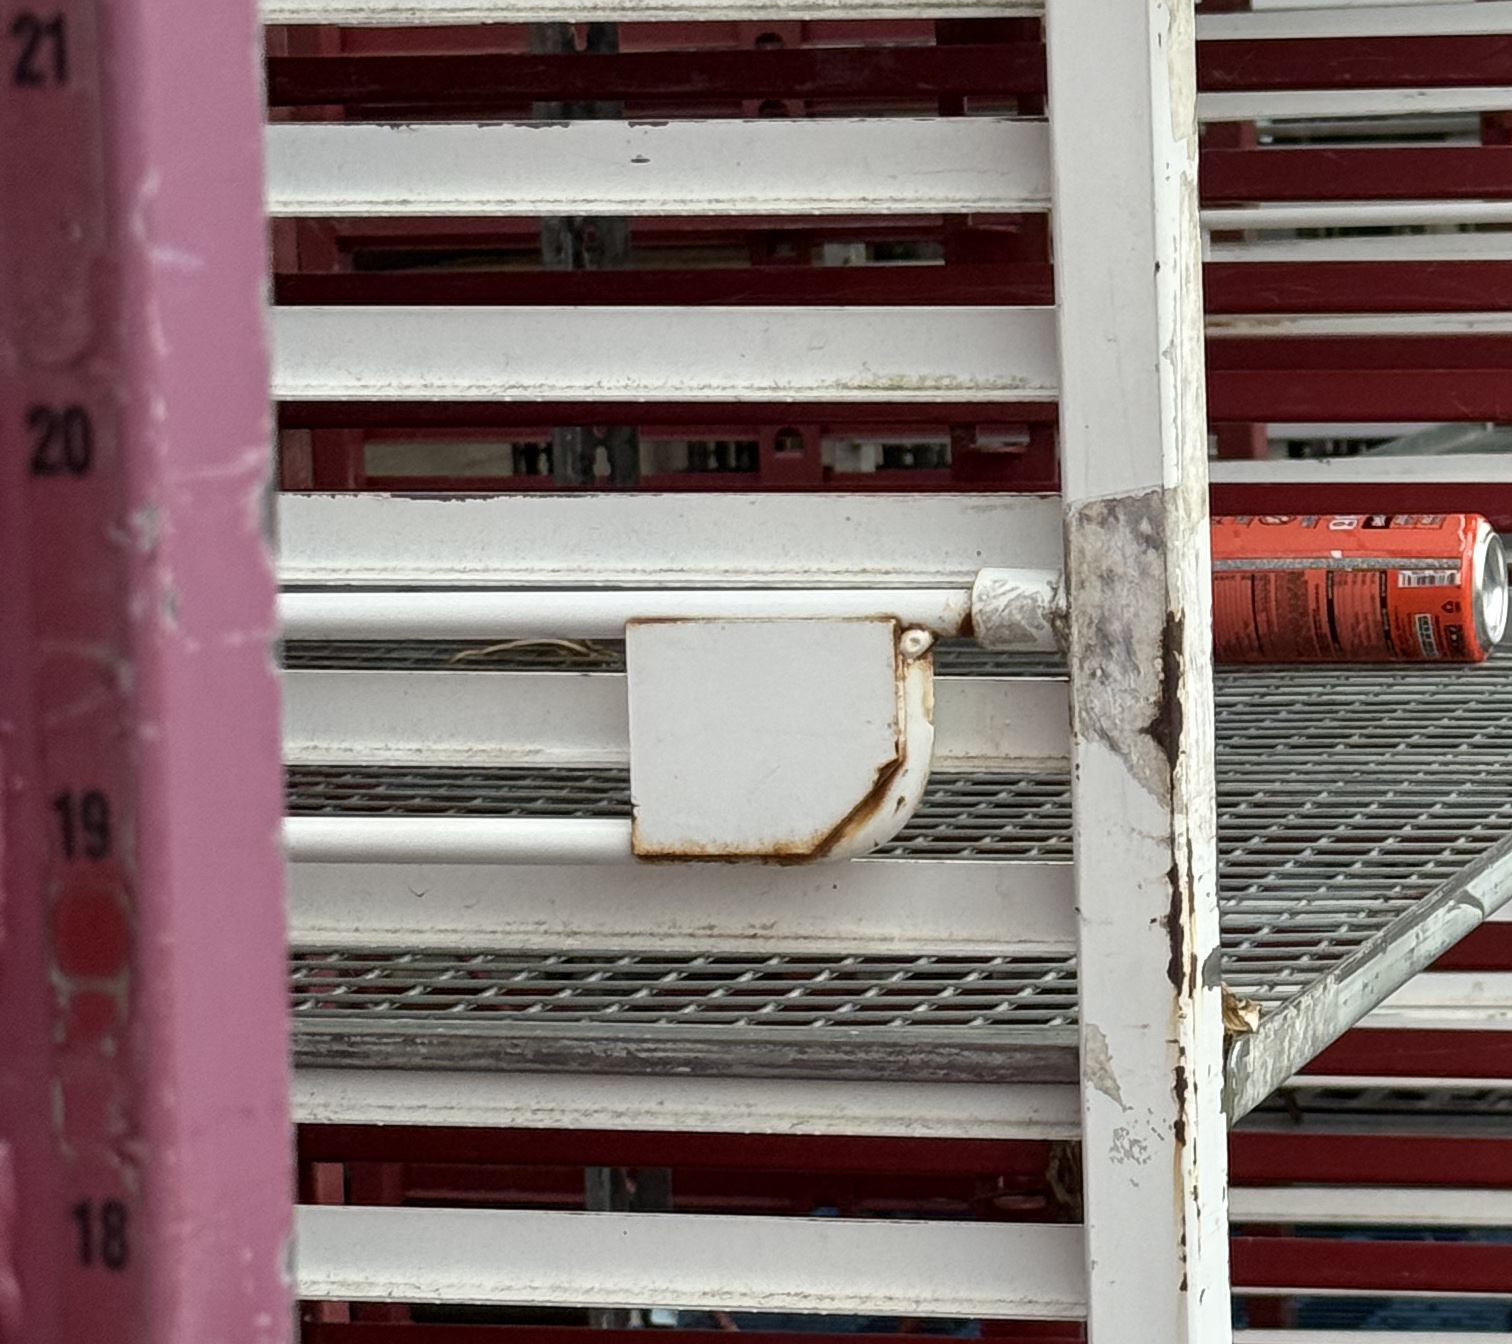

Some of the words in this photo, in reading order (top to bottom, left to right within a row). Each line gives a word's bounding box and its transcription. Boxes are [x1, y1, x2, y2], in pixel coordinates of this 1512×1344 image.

[12, 14, 66, 85] 21
[29, 407, 91, 475] 20
[53, 792, 110, 859] 19
[73, 1201, 127, 1270] 18
